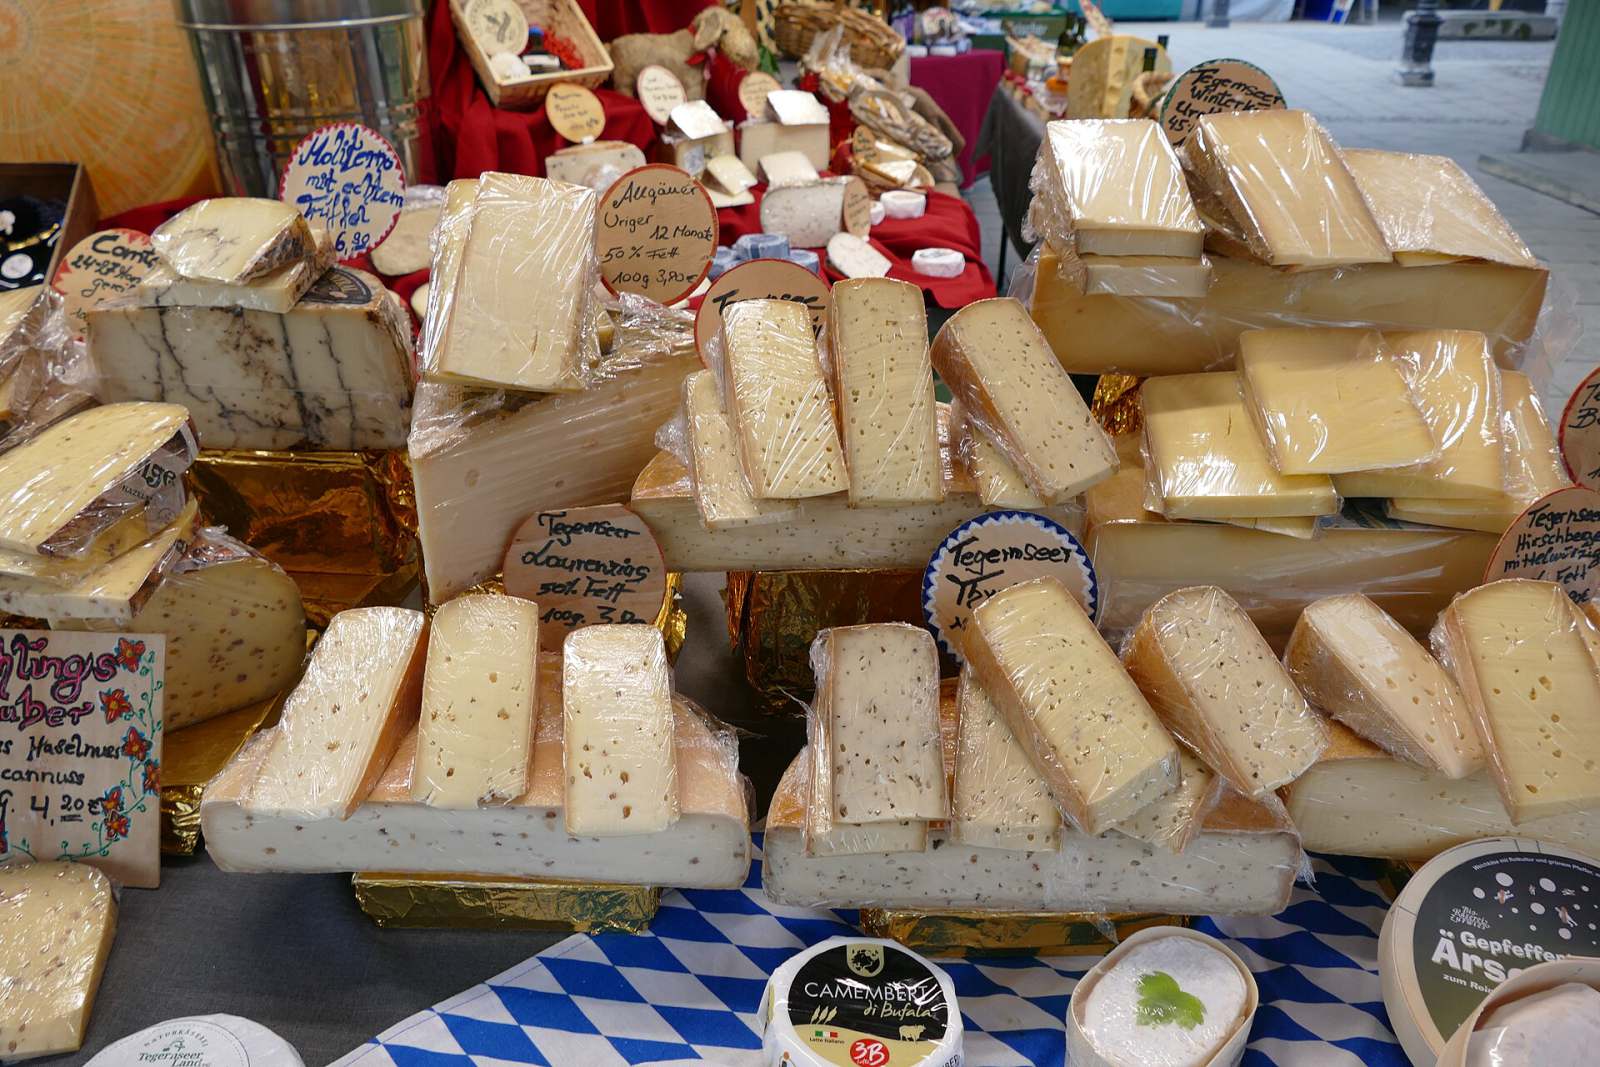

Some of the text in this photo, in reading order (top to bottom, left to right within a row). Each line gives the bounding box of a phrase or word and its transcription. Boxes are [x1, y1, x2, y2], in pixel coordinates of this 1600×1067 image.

[305, 167, 337, 193] mit
[612, 181, 699, 209] Allgäuer
[604, 212, 714, 242] Uriger 12 Monate
[803, 981, 929, 1002] CAMEMBERT
[880, 1000, 933, 1021] Bufala
[139, 1052, 204, 1063] Tegernseer
[854, 1042, 886, 1066] 3B
